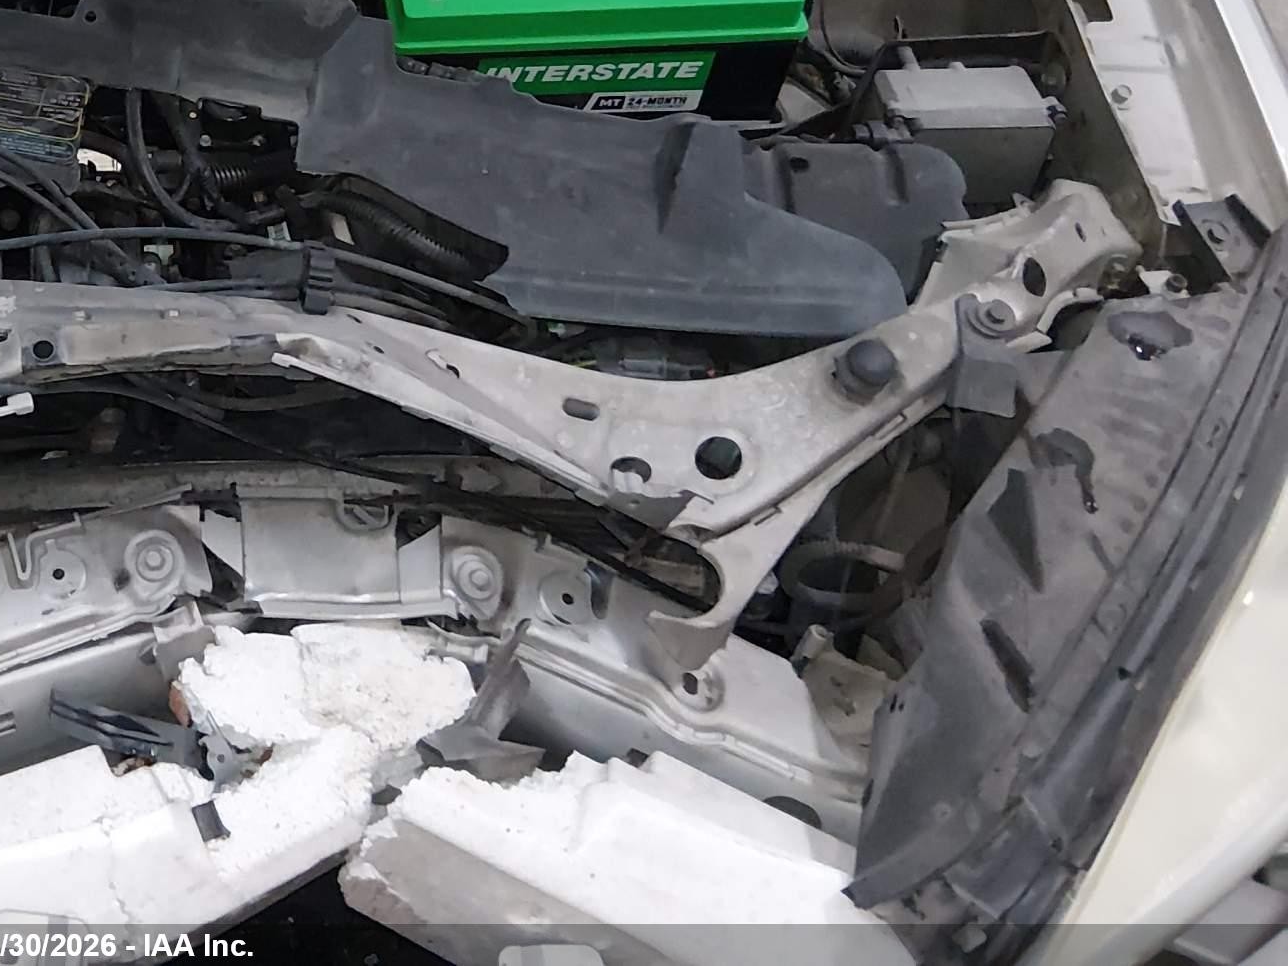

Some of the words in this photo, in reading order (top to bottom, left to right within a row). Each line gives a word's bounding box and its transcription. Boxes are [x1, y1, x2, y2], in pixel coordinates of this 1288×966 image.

[487, 61, 704, 83] INTERSTATE
[598, 98, 623, 108] MT
[626, 96, 688, 106] 24-MONTH
